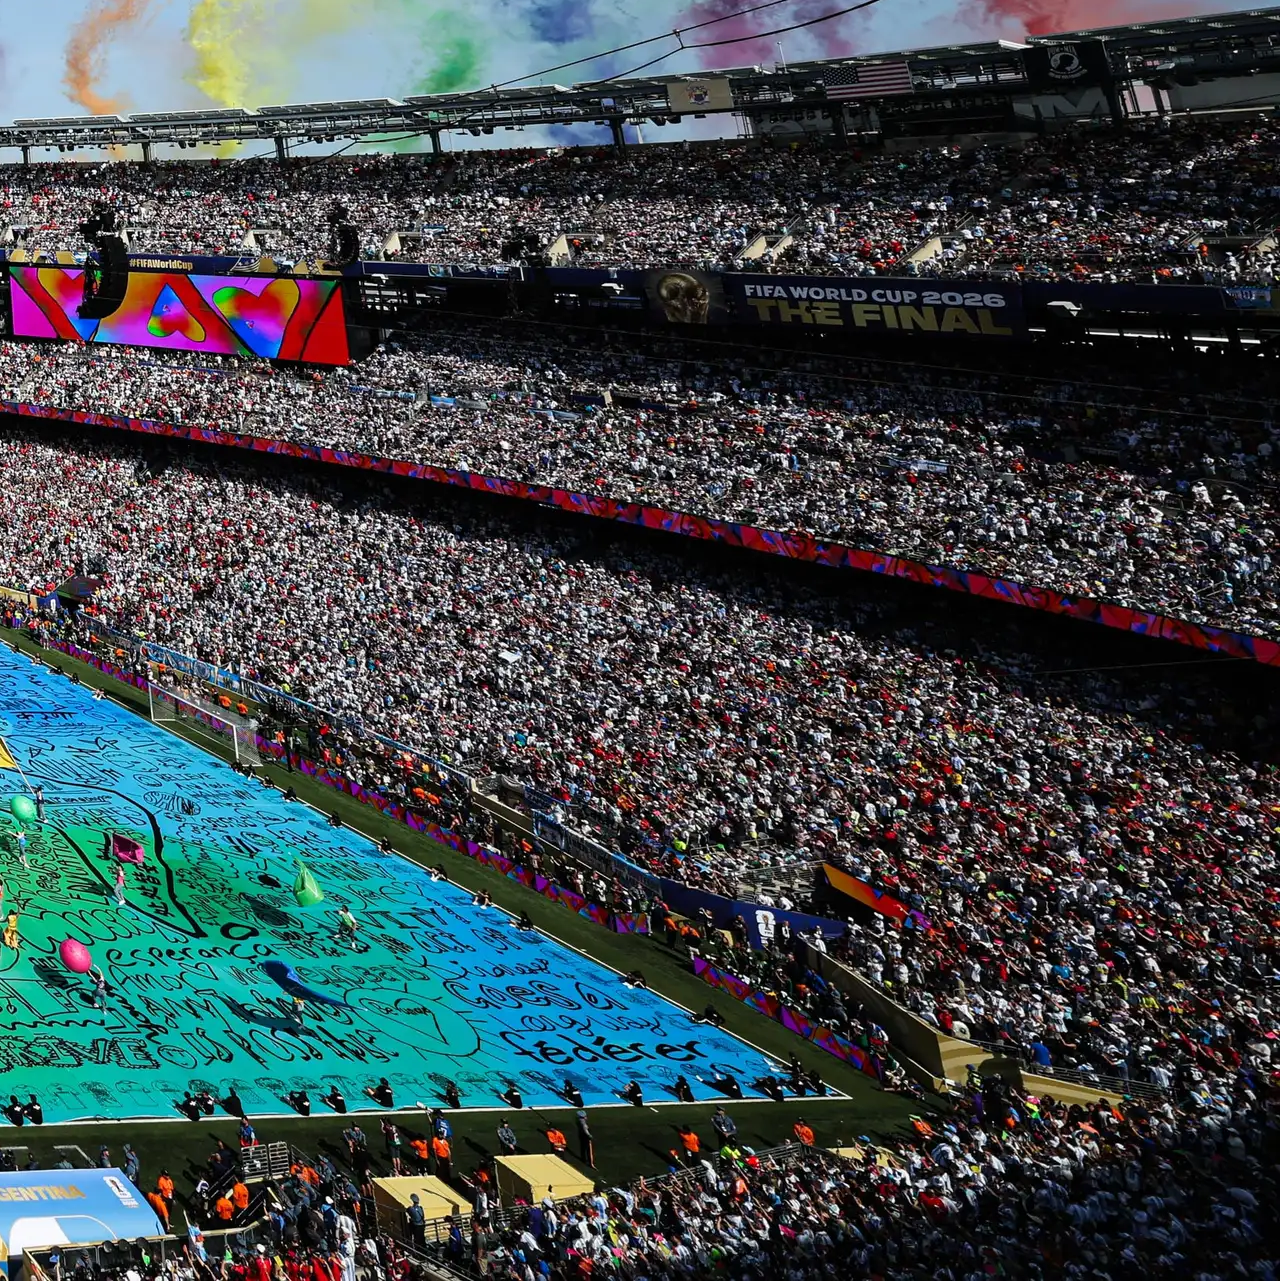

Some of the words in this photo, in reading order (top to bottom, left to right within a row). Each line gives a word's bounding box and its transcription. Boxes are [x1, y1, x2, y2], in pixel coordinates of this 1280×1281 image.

[129, 259, 193, 270] #FIFAWorldCup
[744, 284, 788, 298] FIFA
[790, 286, 867, 302] WORLD
[871, 289, 917, 304] CUP
[921, 291, 1006, 308] 2026
[746, 297, 844, 326] THE
[852, 303, 1013, 336] FINAL
[156, 773, 215, 781] BELIEVE
[44, 814, 157, 829] INVITED
[261, 828, 336, 844] take
[284, 844, 368, 858] action
[106, 942, 274, 968] esperança
[109, 966, 194, 996] Amor
[484, 1027, 731, 1066] fédérer
